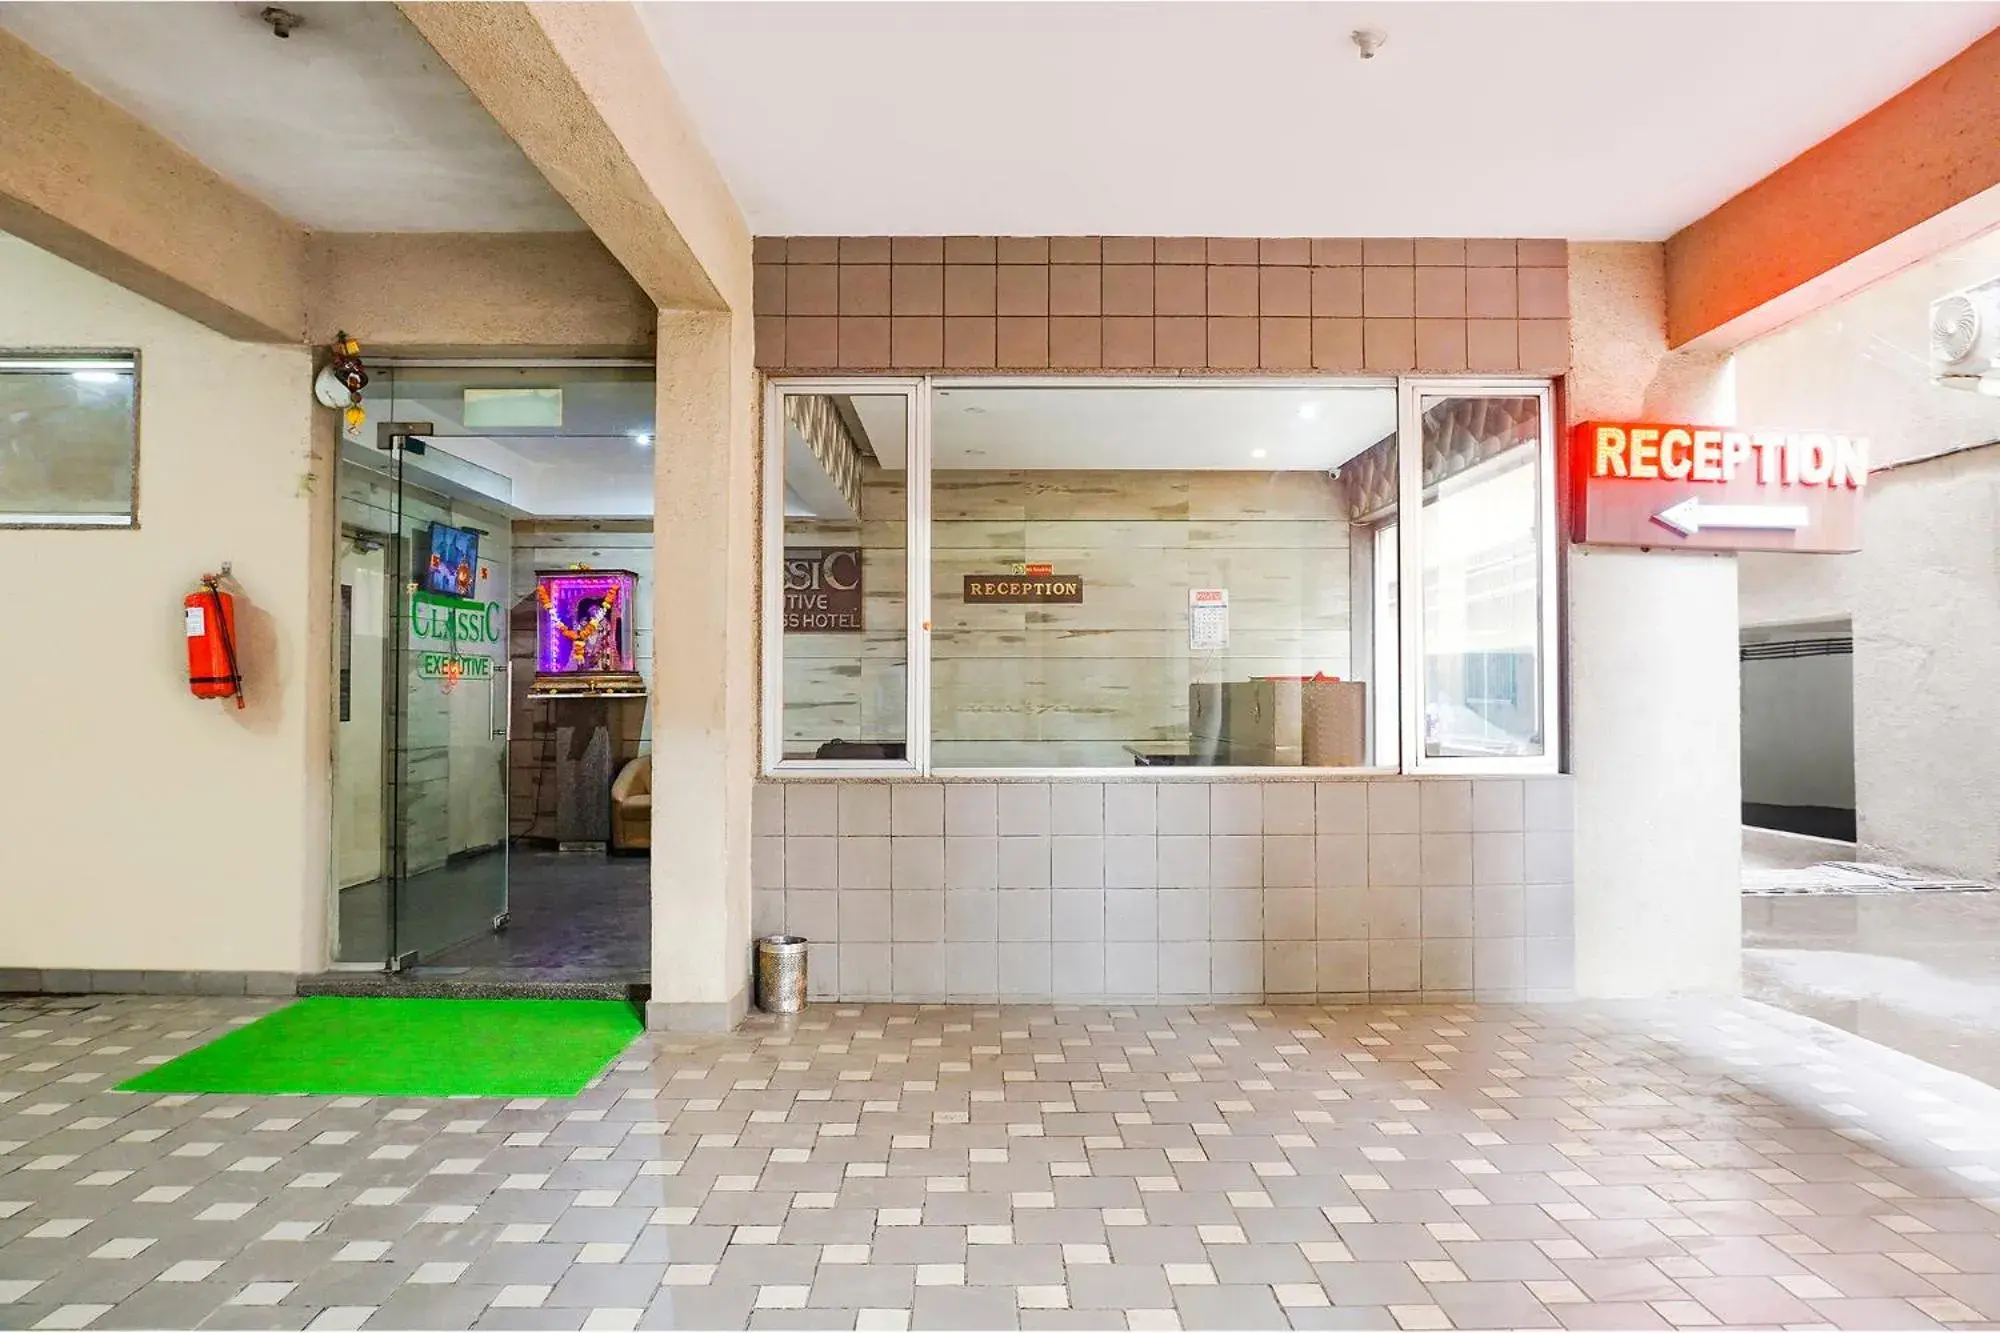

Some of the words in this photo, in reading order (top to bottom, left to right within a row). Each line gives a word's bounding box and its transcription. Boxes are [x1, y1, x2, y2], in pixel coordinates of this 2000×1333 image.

[1594, 426, 1869, 488] RECEPTION
[970, 583, 1078, 596] RECEPTION
[784, 594, 828, 609] TIVE
[803, 613, 861, 628] HOTEL
[424, 655, 489, 675] EXEUTIVE
